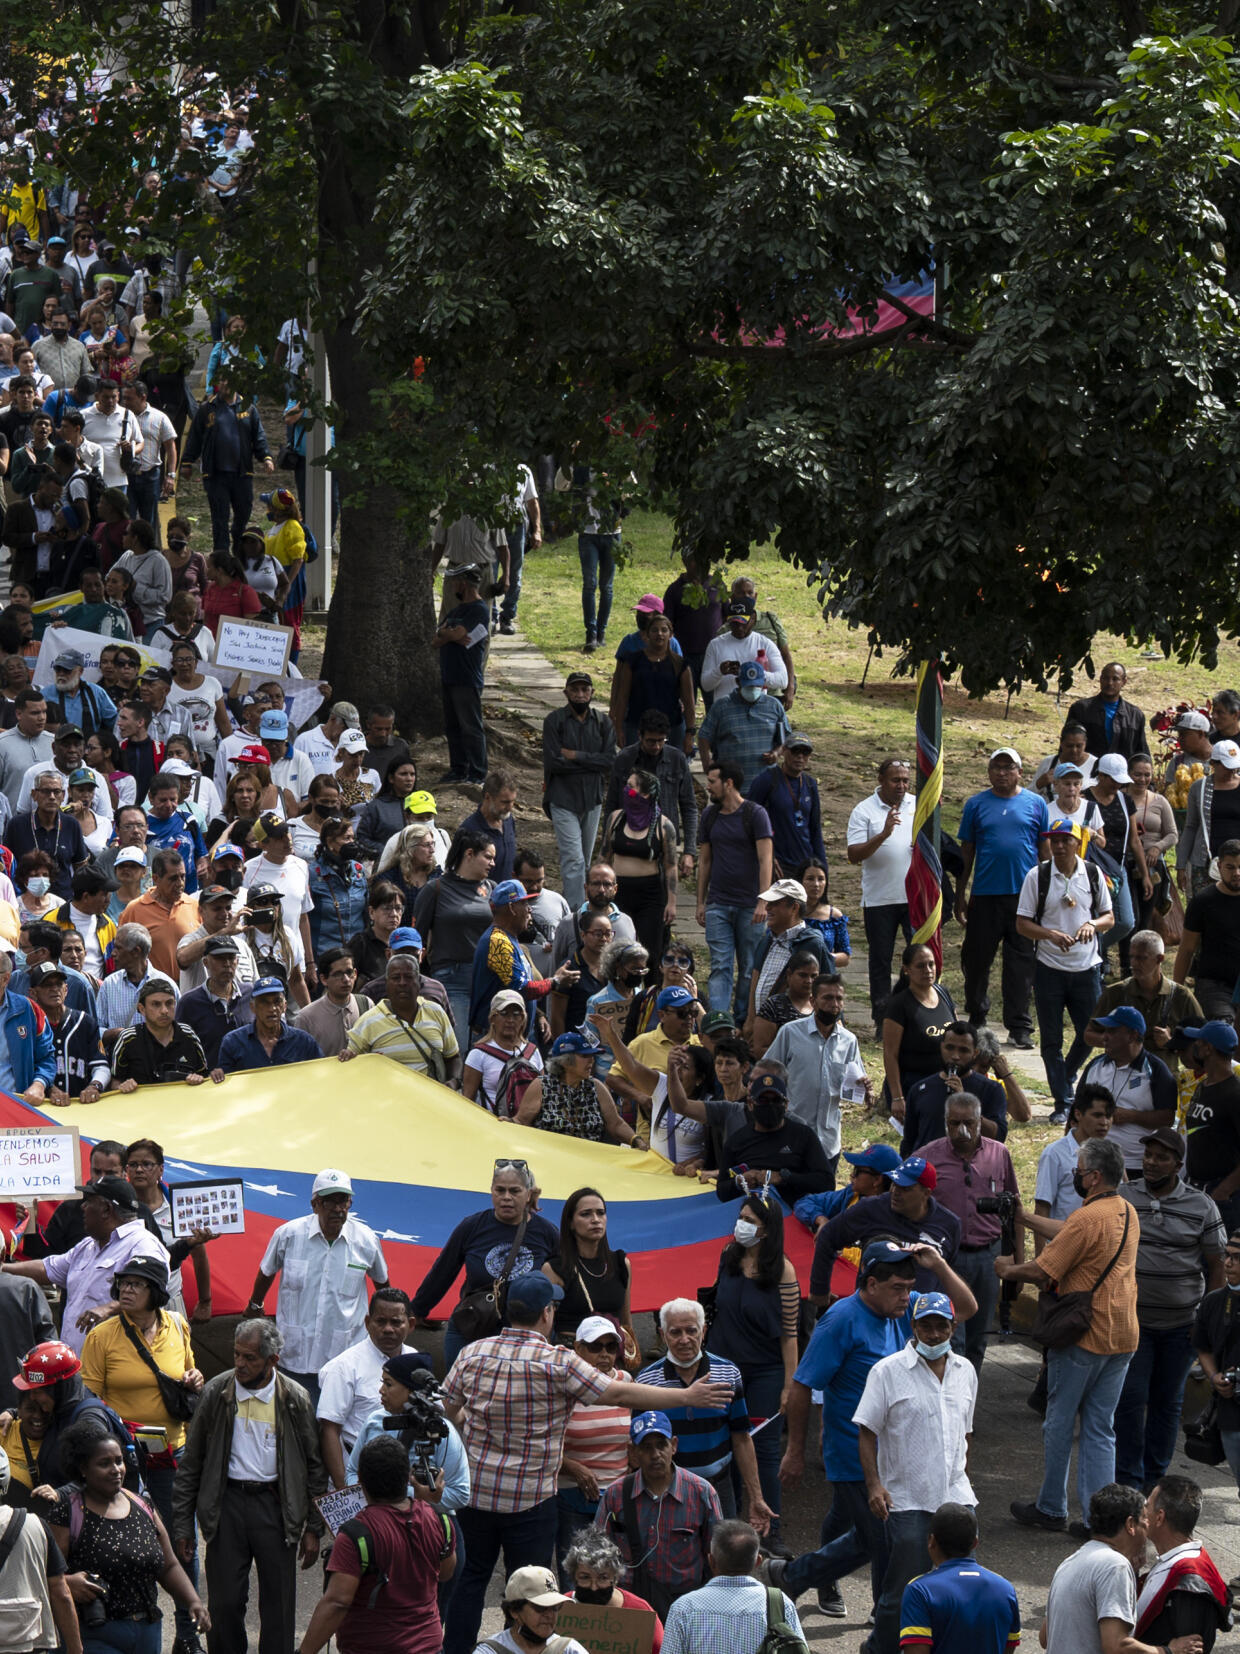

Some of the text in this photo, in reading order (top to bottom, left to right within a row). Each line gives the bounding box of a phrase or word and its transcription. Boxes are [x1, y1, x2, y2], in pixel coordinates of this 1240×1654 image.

[19, 1152, 61, 1166] SALUD
[0, 1177, 15, 1188] LA
[22, 1174, 61, 1187] VIDA
[322, 1497, 350, 1514] ABAJO
[556, 1611, 623, 1634] mento
